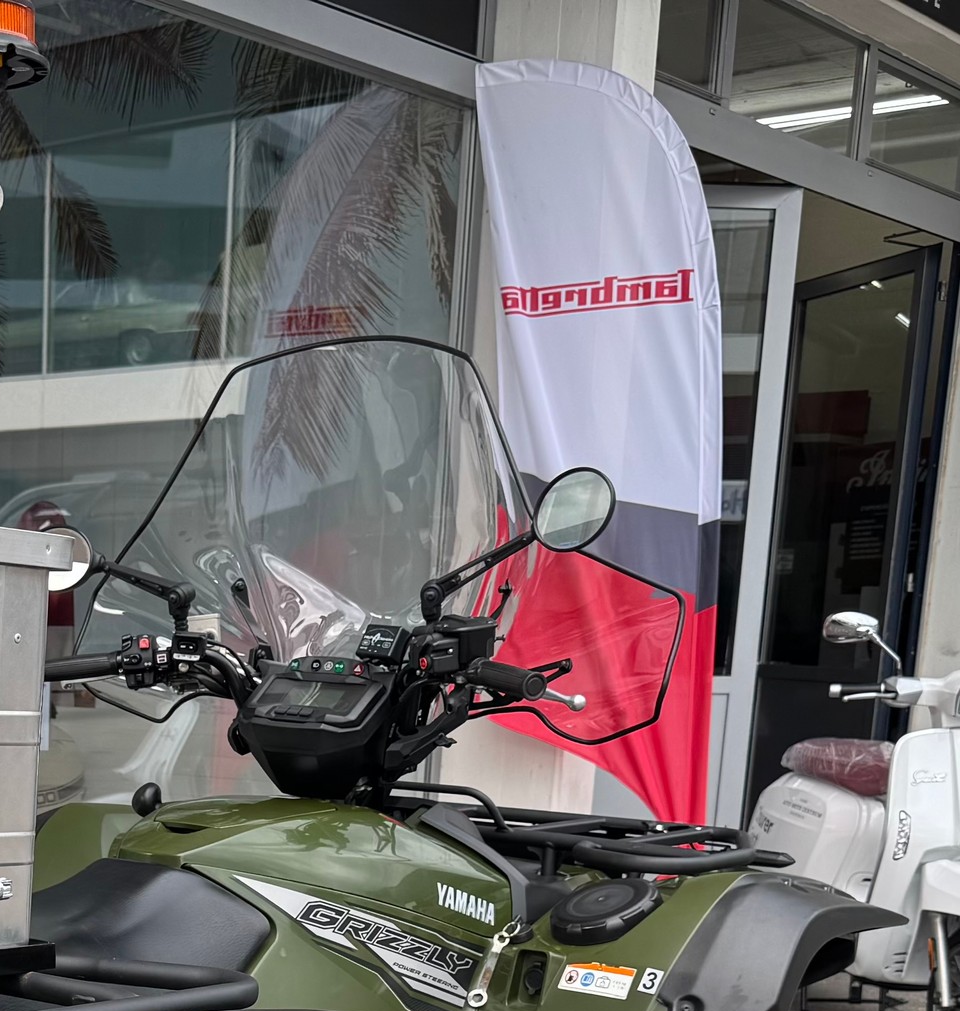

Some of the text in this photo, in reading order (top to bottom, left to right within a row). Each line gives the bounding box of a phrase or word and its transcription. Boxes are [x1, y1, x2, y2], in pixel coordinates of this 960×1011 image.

[437, 882, 495, 926] YAMAHA
[296, 901, 473, 974] GRIZZLY
[392, 961, 459, 991] POWER STEERING
[642, 972, 658, 990] 3
